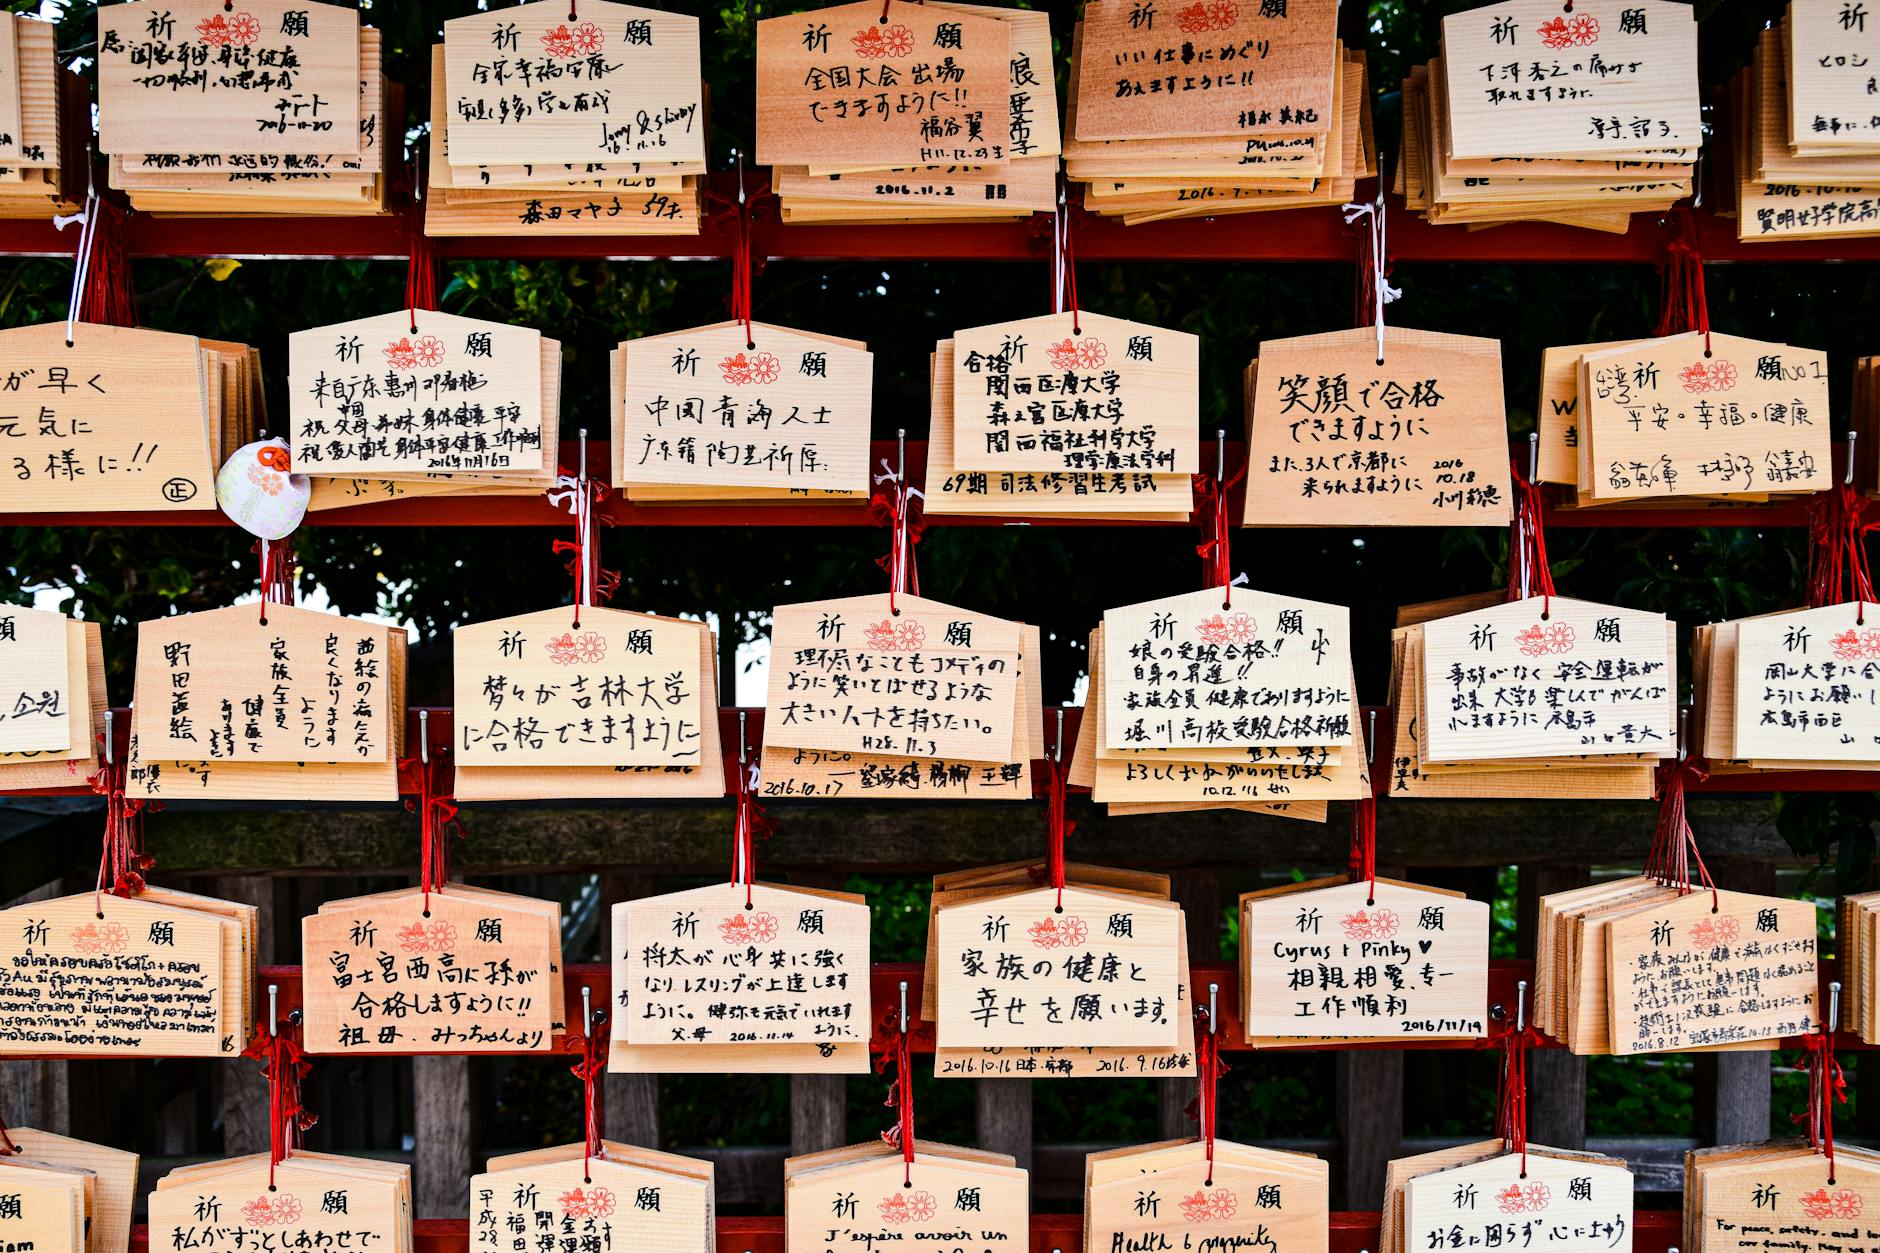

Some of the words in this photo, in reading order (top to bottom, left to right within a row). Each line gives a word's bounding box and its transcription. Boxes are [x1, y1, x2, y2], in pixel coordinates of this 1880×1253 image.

[146, 10, 177, 42] 祈
[280, 10, 310, 38] 願
[1127, 1, 1158, 31] 祈
[1490, 16, 1520, 46] 祈
[1618, 8, 1648, 35] 願
[1838, 2, 1869, 33] 祈
[491, 23, 522, 53] 祈
[623, 19, 653, 46] 願
[802, 23, 833, 54] 祈
[932, 22, 963, 50] 願
[1115, 40, 1270, 67] いい仕事にめぐり
[805, 64, 903, 91] 全国大会
[911, 56, 965, 85] 出場
[335, 335, 364, 365] 祈
[464, 332, 493, 358] 願
[671, 347, 701, 377] 祈
[798, 351, 827, 379] 願
[963, 351, 1012, 376] 合格
[1000, 334, 1029, 364] 祈
[1125, 335, 1153, 362] 願
[1632, 361, 1661, 390] 祈
[1754, 355, 1782, 381] 願
[1277, 372, 1445, 416] 笑顔で合格
[1289, 413, 1430, 444] できますように
[1432, 458, 1464, 470] 2016
[1301, 474, 1423, 499] 来られますように
[816, 613, 846, 643] 祈
[943, 621, 973, 649] 願
[1149, 612, 1177, 641] 祈
[1276, 610, 1304, 636] 願
[1469, 624, 1497, 652] 祈
[1594, 618, 1622, 643] 願
[1783, 625, 1812, 655] 祈
[498, 630, 527, 660] 祈
[625, 629, 653, 656] 願
[464, 713, 700, 758] に合格できますように
[23, 918, 51, 950] 祈
[147, 920, 175, 947] 願
[350, 919, 378, 949] 祈
[474, 917, 503, 944] 願
[671, 911, 700, 940] 祈
[796, 909, 824, 935] 願
[982, 915, 1011, 943] 祈
[1106, 913, 1133, 939] 願
[1295, 907, 1323, 935] 祈
[1417, 906, 1445, 932] 願
[1650, 919, 1675, 947] 祈
[1756, 908, 1779, 933] 願
[961, 948, 1146, 984] 家族の健康と
[1273, 942, 1331, 964] Cyrus
[1361, 940, 1411, 967] Pinky
[350, 991, 532, 1019] 合格しますように!!
[970, 987, 1168, 1028] 幸せを願います。
[1294, 993, 1407, 1019] 工作順利
[1401, 1018, 1482, 1034] 2016/11/19
[0, 1193, 23, 1220] 願
[193, 1195, 223, 1223] 祈
[320, 1189, 348, 1215] 願
[513, 1183, 541, 1212] 祈
[634, 1186, 661, 1213] 願
[832, 1192, 860, 1220] 祈
[954, 1187, 981, 1212] 願
[1134, 1190, 1161, 1219] 祈
[1255, 1184, 1282, 1210] 願
[1453, 1183, 1479, 1210] 祈
[1567, 1176, 1592, 1201] 願
[1751, 1183, 1781, 1212] 祈
